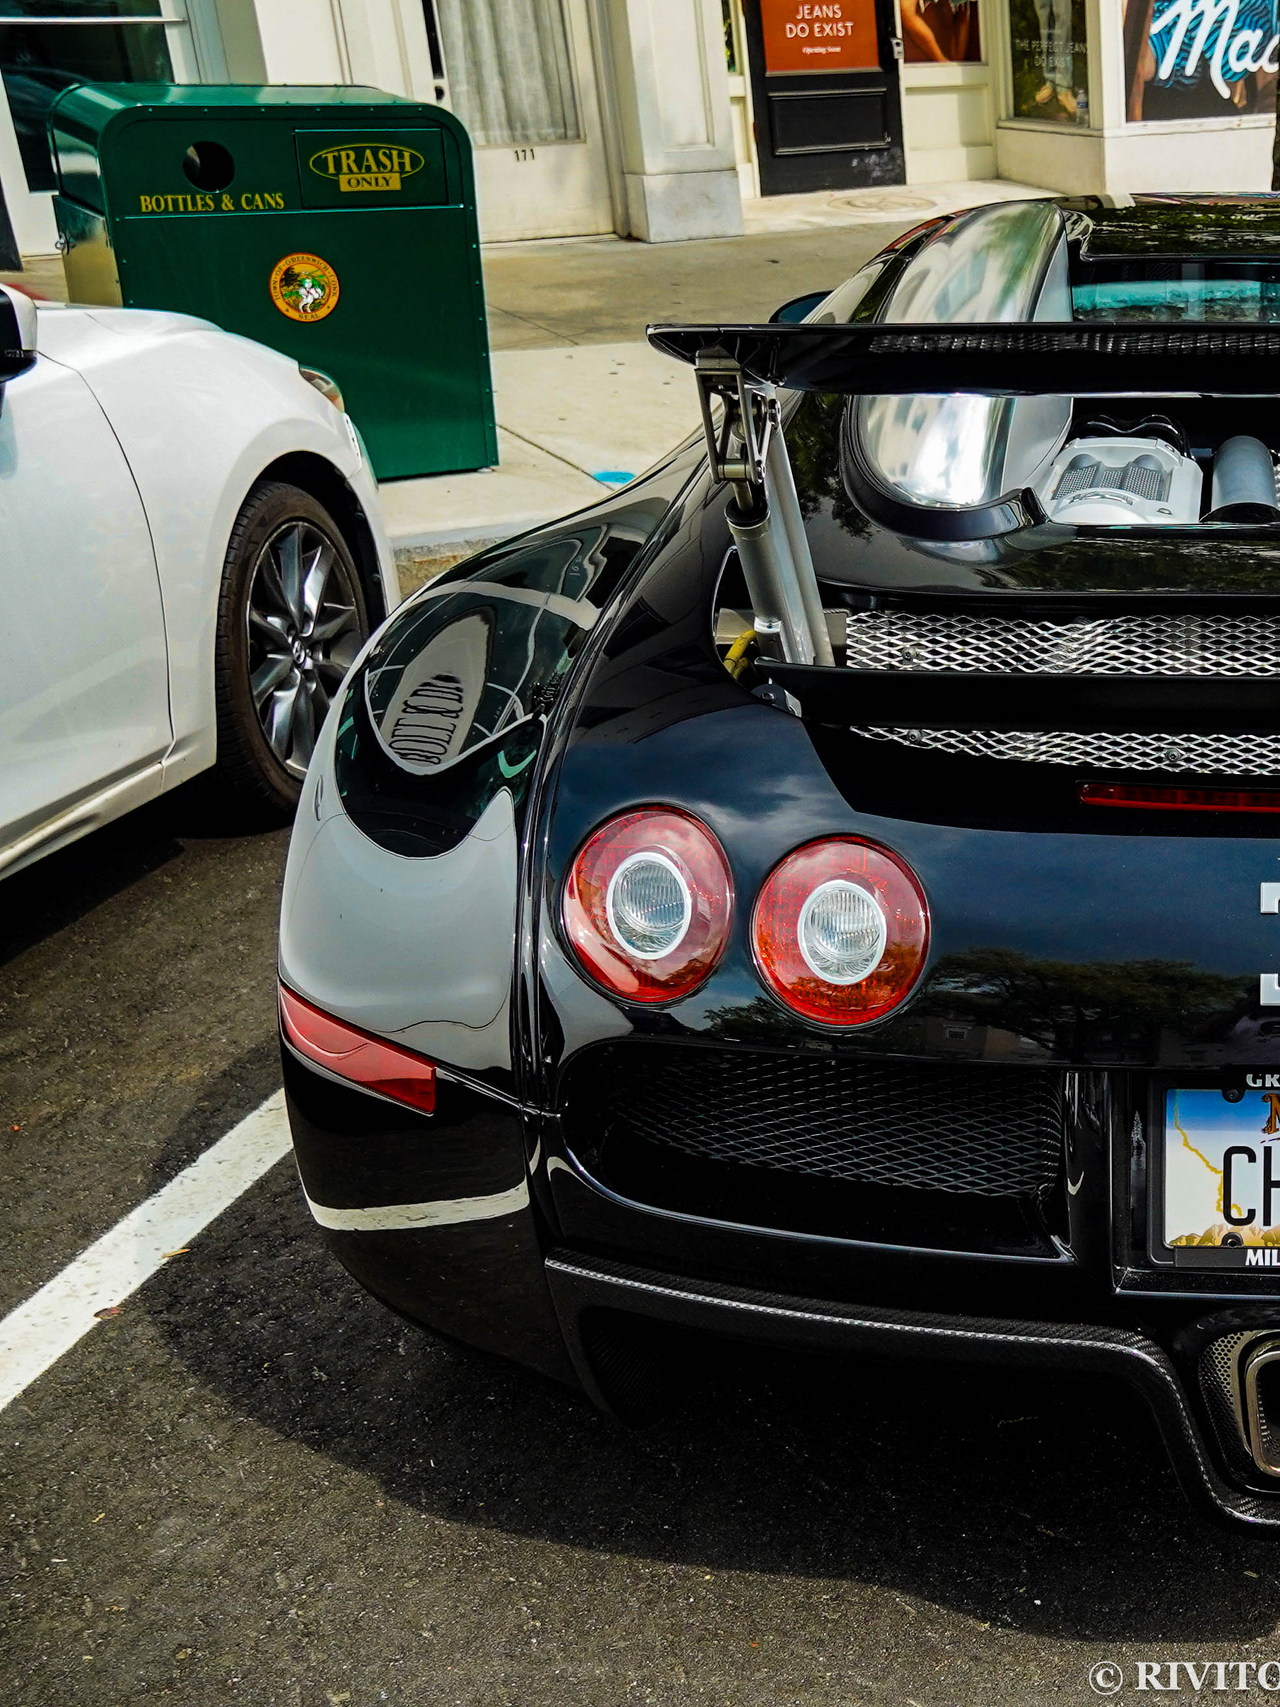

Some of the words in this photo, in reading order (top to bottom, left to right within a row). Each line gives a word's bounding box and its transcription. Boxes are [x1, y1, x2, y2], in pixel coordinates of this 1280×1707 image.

[796, 4, 842, 19] JEANS
[785, 22, 810, 38] DO
[813, 21, 854, 37] EXIST
[321, 148, 413, 174] TRASH
[514, 148, 535, 162] 171
[347, 176, 392, 188] ONLY
[140, 194, 215, 212] BOTTLES
[221, 193, 235, 211] &
[241, 192, 285, 210] CANS
